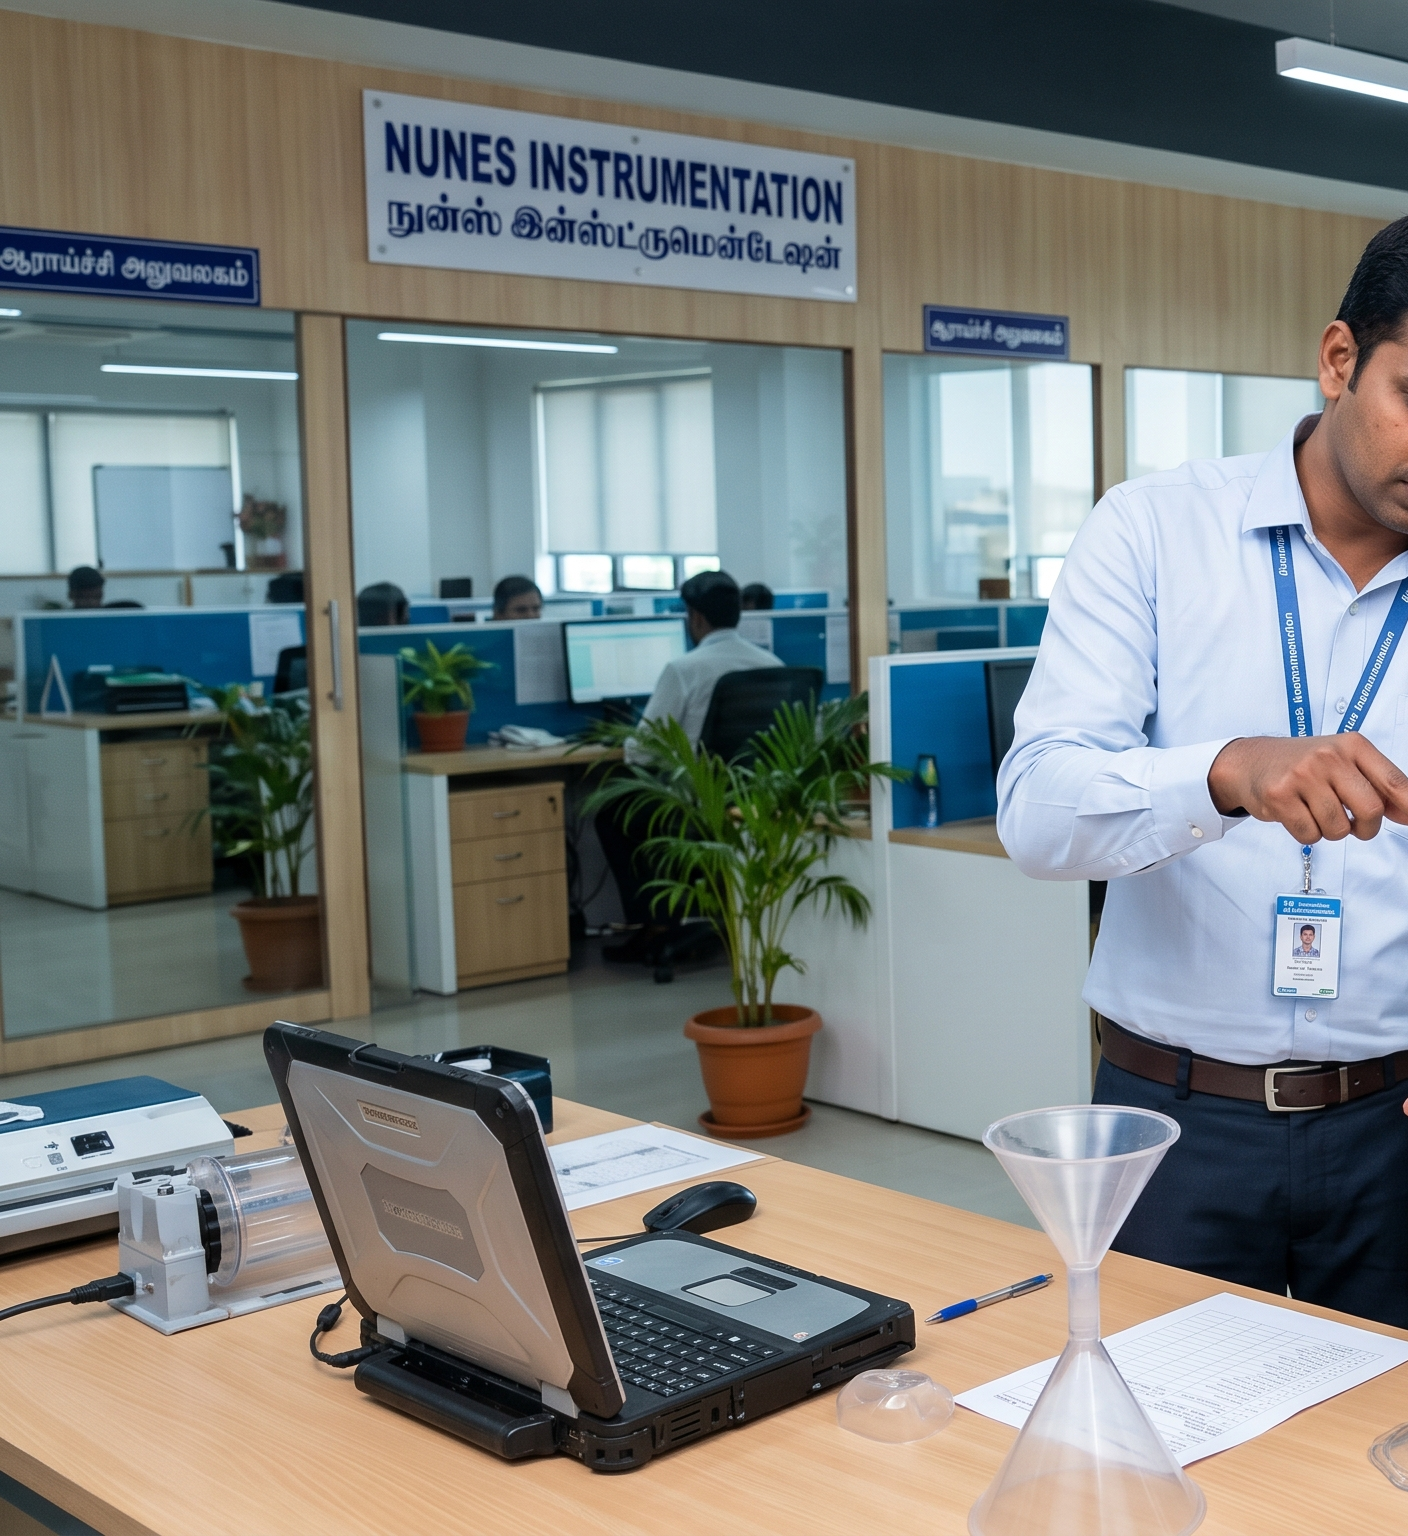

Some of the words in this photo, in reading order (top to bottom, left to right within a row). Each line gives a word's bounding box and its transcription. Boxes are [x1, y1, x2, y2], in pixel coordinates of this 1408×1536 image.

[384, 121, 517, 188] NUNES
[529, 140, 843, 226] INSTRUMENTATION
[0, 247, 115, 276] ஆராய்ச்சி
[121, 257, 249, 290] அலுவலகம்
[387, 192, 502, 239] நுன்ஸ்
[510, 205, 842, 274] இன்ஸ்ட்ருமென்டேஷன்
